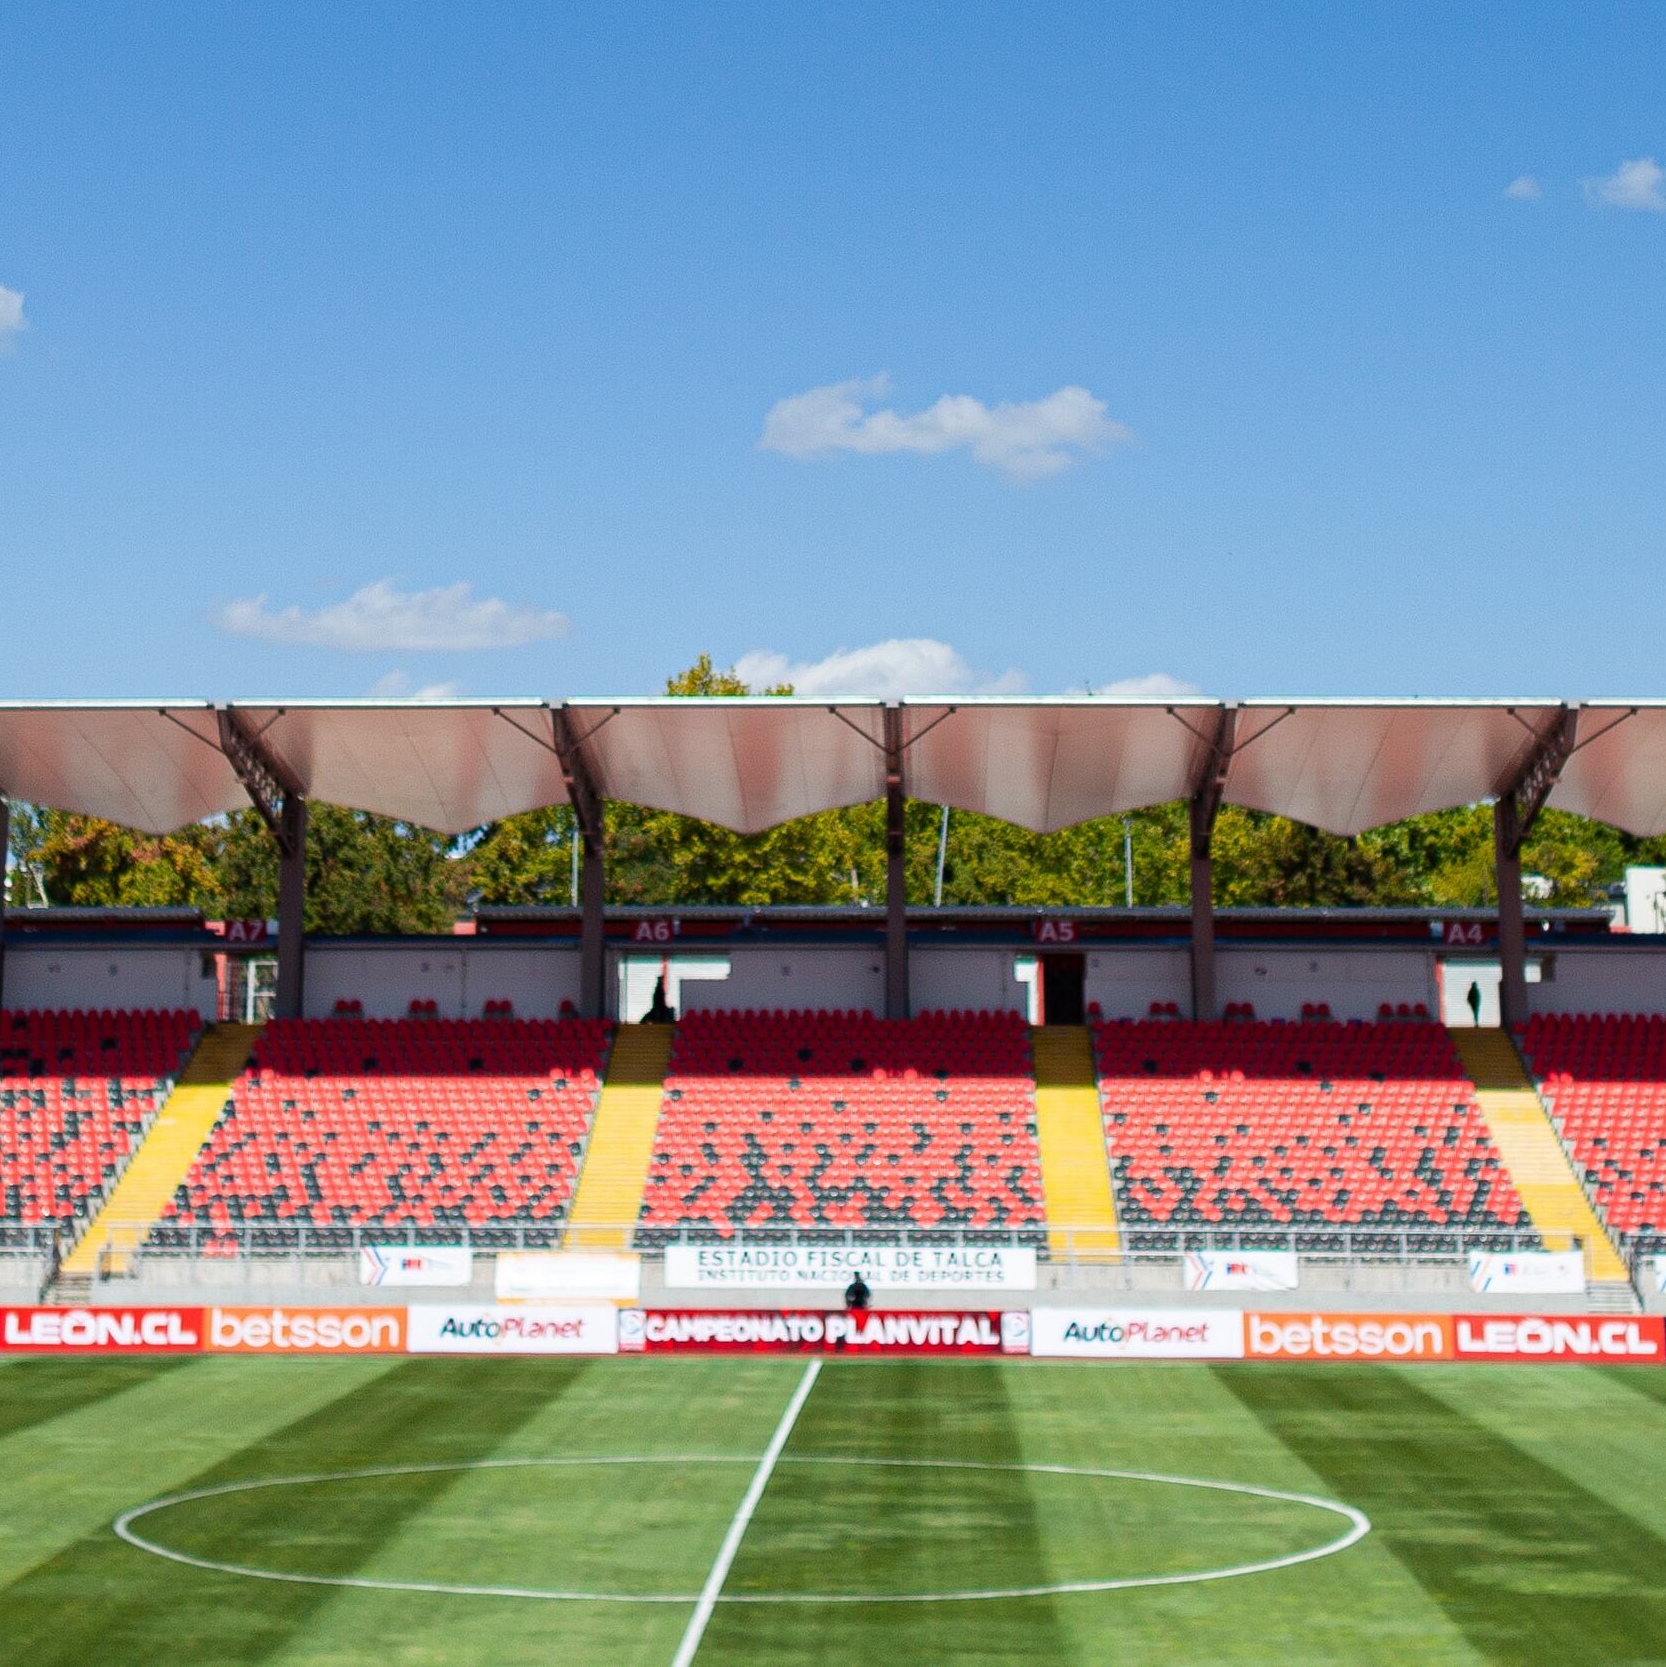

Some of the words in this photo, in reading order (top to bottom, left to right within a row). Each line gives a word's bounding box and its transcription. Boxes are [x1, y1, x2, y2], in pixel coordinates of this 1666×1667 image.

[228, 920, 264, 941] A7
[635, 921, 671, 941] A6
[1039, 922, 1075, 942] A5
[1447, 923, 1483, 944] A4
[698, 1250, 798, 1266] ESTADIO
[807, 1251, 885, 1267] FISCAL
[895, 1251, 923, 1267] DE
[933, 1252, 1004, 1267] TALCA
[698, 1269, 790, 1282] INSTITUTO
[891, 1270, 911, 1282] DE
[918, 1270, 1005, 1283] DEPORTES
[210, 1308, 399, 1348] betsson
[439, 1313, 586, 1339] AutoPlanet
[645, 1313, 824, 1343] CAMPEONATO
[825, 1314, 1000, 1345] PLANVITAL
[1062, 1319, 1210, 1344] AutoPlanet
[1249, 1314, 1444, 1355] betsson
